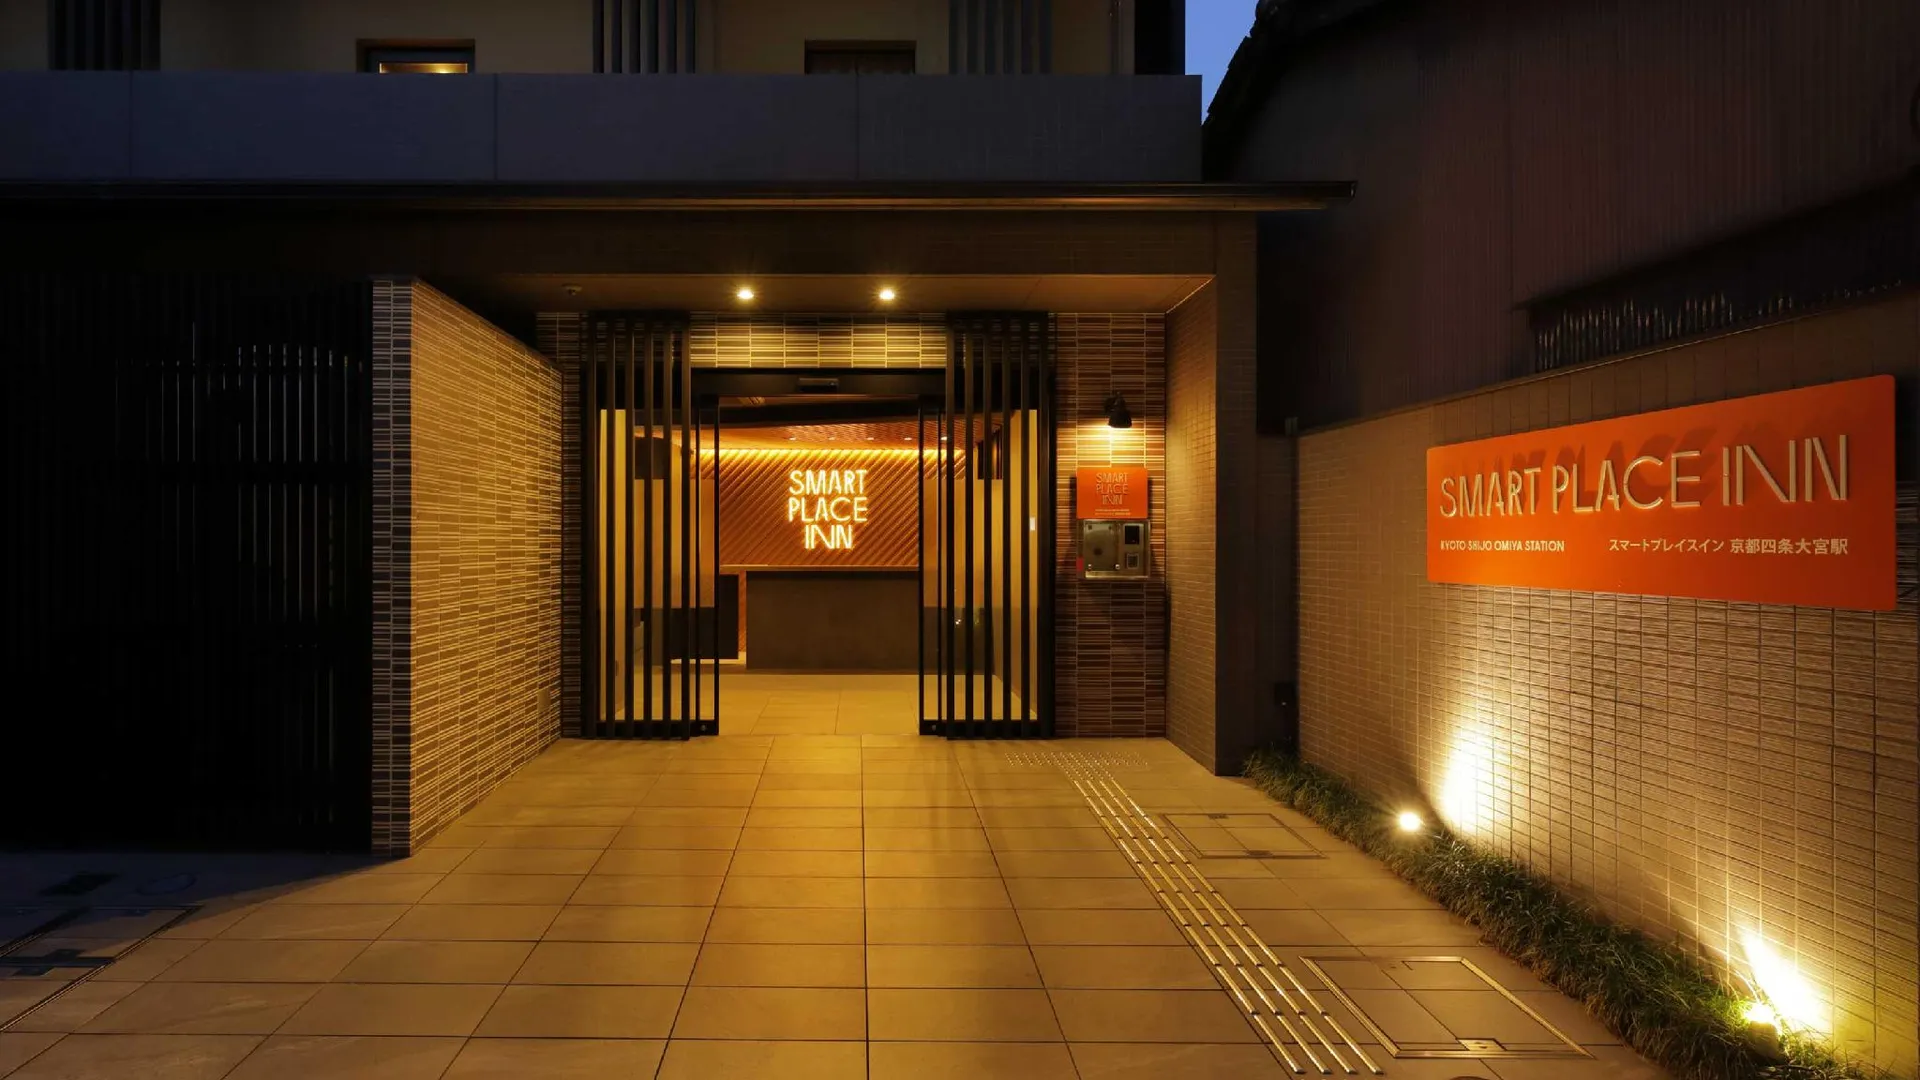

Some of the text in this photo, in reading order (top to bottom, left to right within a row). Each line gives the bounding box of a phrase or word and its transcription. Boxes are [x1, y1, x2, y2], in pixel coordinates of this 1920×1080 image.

[789, 469, 868, 495] SMART
[1096, 472, 1129, 484] SMART
[1440, 434, 1849, 518] SMART PLACE INN
[1096, 484, 1129, 494] PLACE
[1102, 495, 1123, 505] INN
[788, 496, 868, 522] PLACE
[805, 524, 853, 550] INN
[1440, 540, 1565, 552] KYOTO SHIJO OMIYA STATION
[1609, 538, 1849, 555] スマートプレイスイン 京都四条大宮駅
